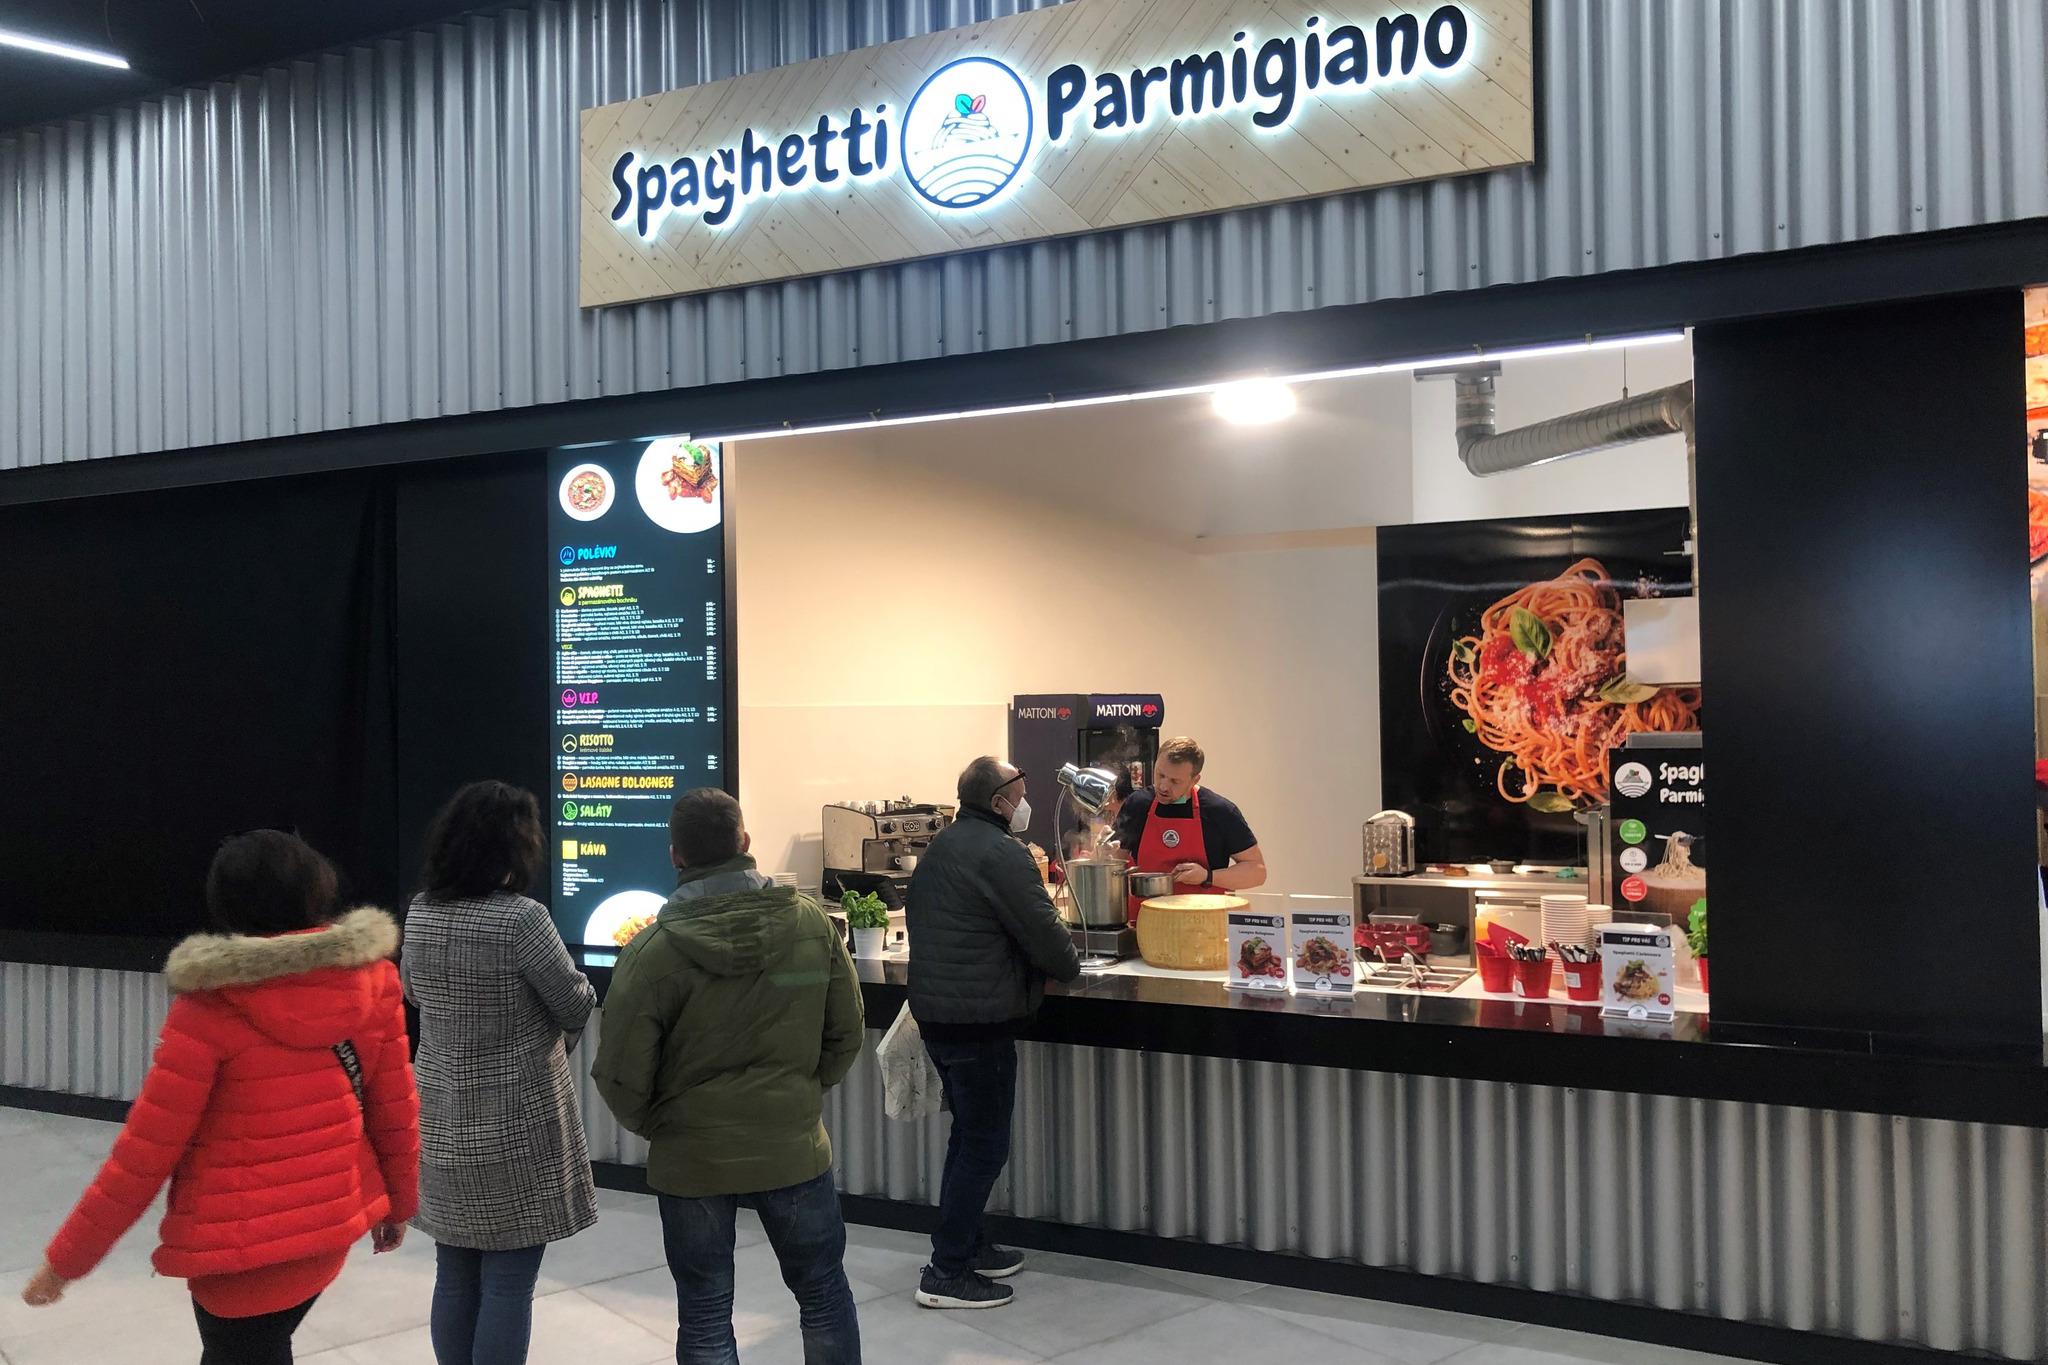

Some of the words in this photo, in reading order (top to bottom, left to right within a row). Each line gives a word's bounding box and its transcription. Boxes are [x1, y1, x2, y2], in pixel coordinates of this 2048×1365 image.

[611, 103, 889, 236] Spaghetti
[1046, 4, 1468, 141] Parmigiano
[578, 545, 616, 560] POLÉVKY
[578, 584, 623, 598] SPAGHETTI
[578, 692, 599, 704] V.I.P.
[1018, 706, 1057, 719] MATTONI
[1096, 704, 1141, 717] MATTONI
[579, 733, 614, 747] RISOTTO
[580, 776, 620, 789] LASAGNE
[622, 775, 674, 789] BOLOGNESE
[1660, 787, 1705, 807] Parmi
[580, 803, 613, 818] SALÁTY
[580, 840, 607, 856] KÁVA
